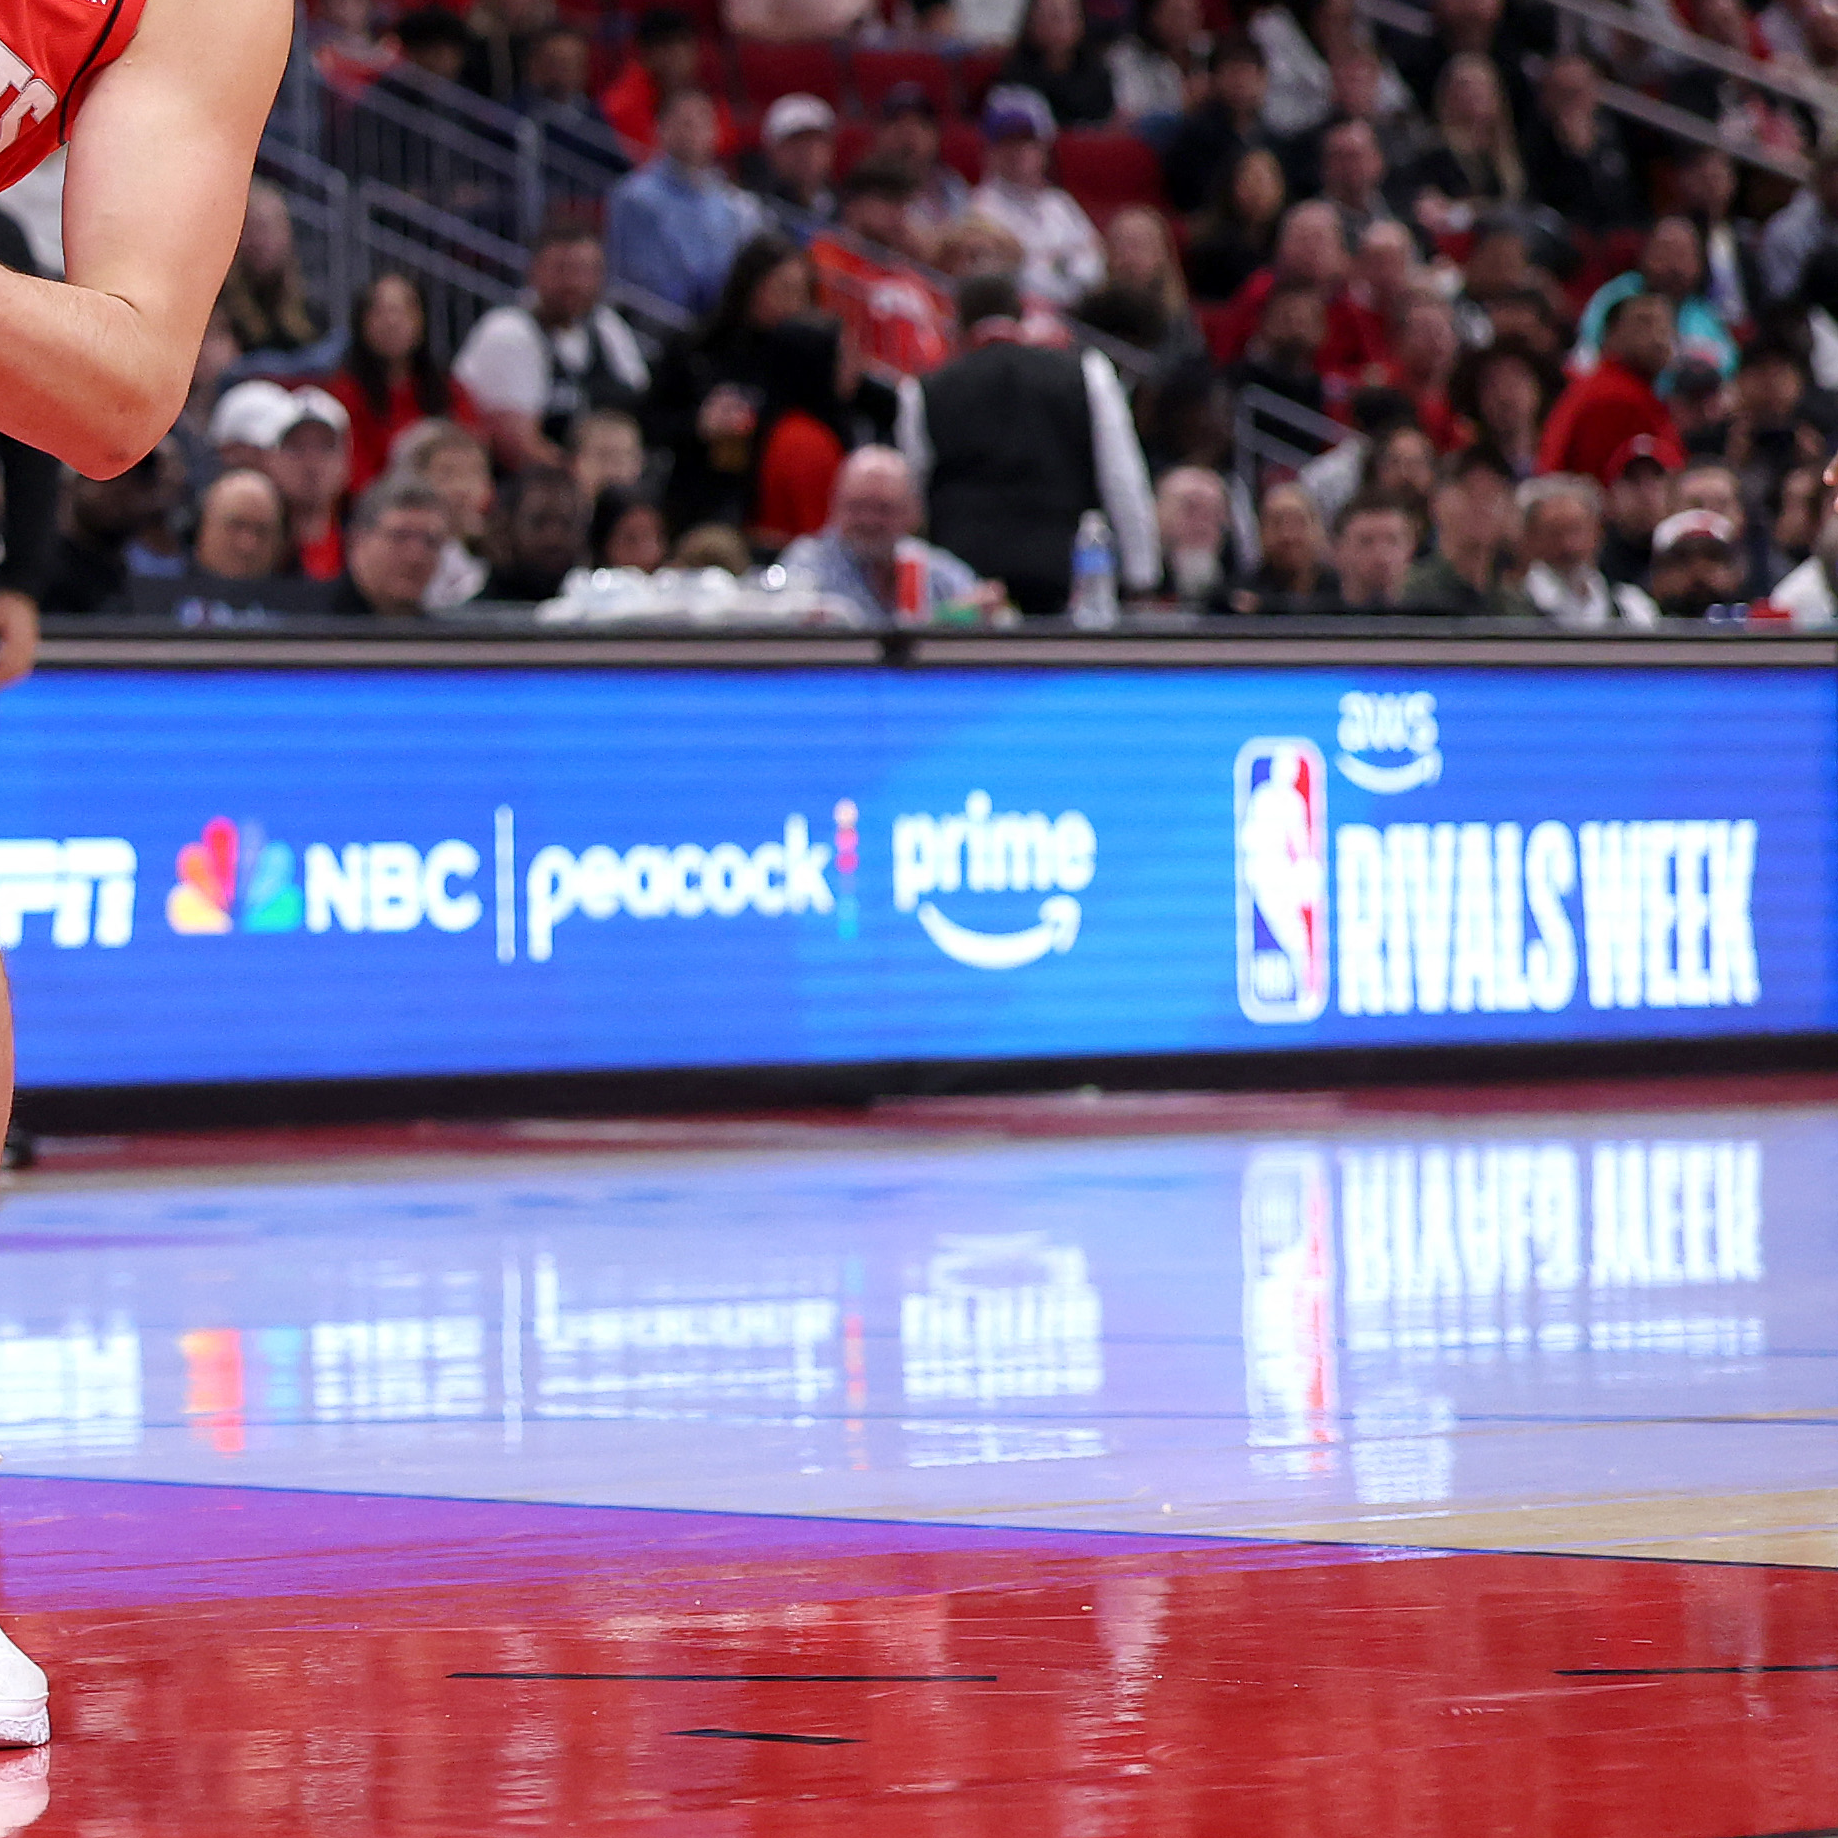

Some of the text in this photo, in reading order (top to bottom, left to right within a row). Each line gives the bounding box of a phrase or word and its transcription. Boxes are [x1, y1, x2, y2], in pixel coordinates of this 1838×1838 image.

[303, 839, 483, 933] NBC
[526, 813, 835, 962] peacock
[892, 789, 1098, 912] prime
[1335, 818, 1762, 1017] RIVALS WEEK
